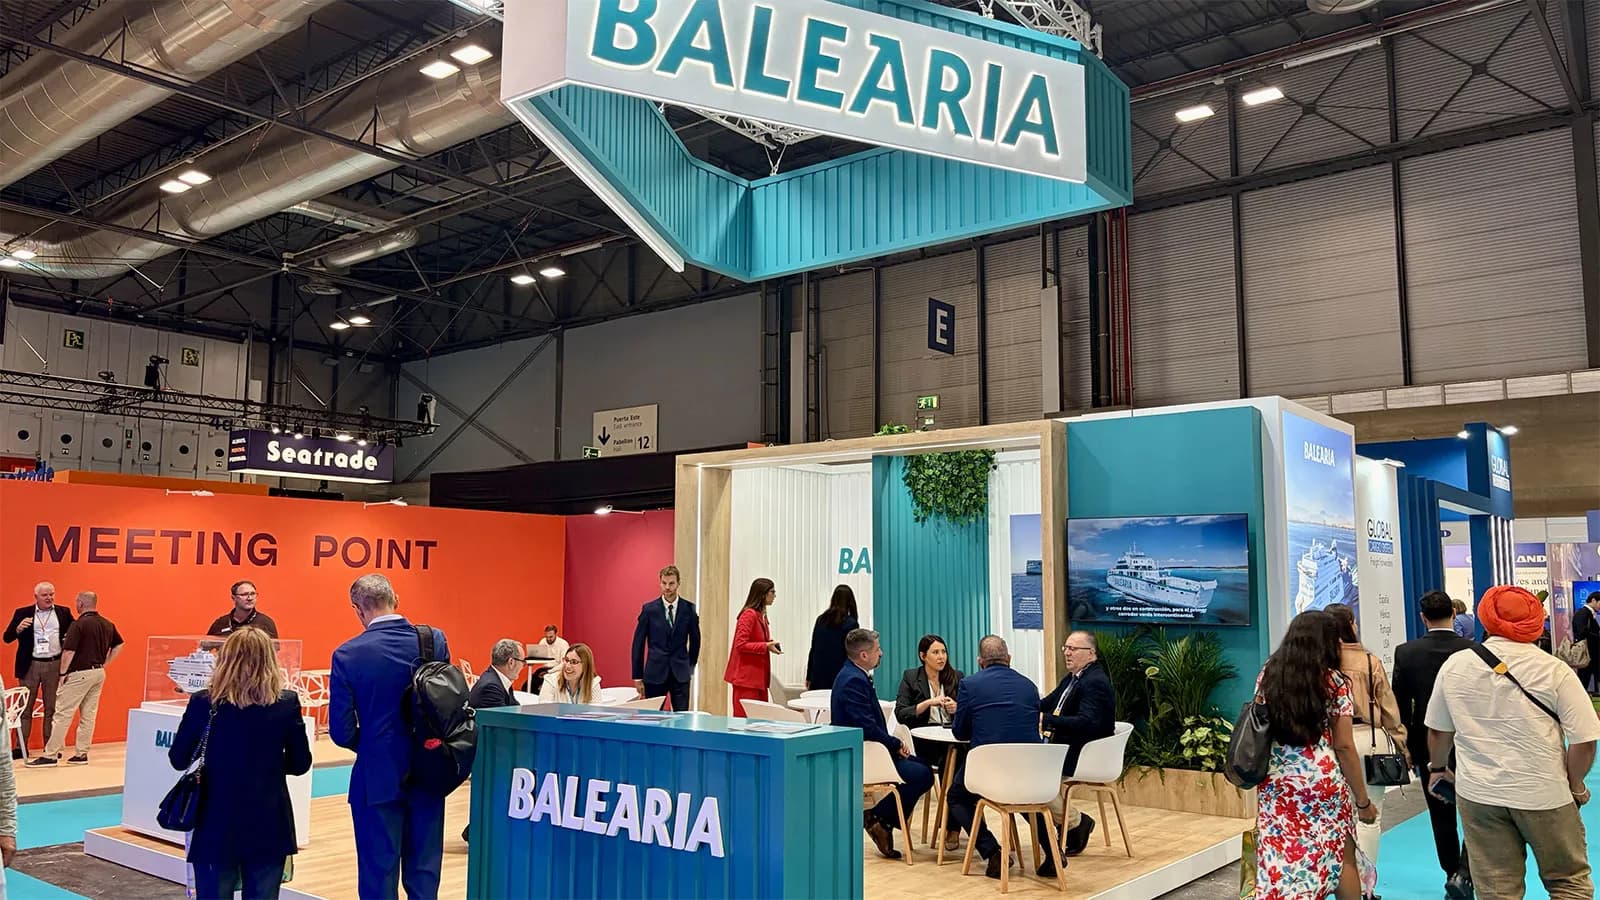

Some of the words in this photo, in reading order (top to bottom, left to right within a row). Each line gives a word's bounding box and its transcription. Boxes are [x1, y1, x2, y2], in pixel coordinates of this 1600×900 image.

[936, 309, 948, 344] E
[267, 440, 378, 470] Seatrade
[637, 436, 650, 449] 12
[34, 525, 278, 567] MEETING
[312, 535, 438, 570] POINT
